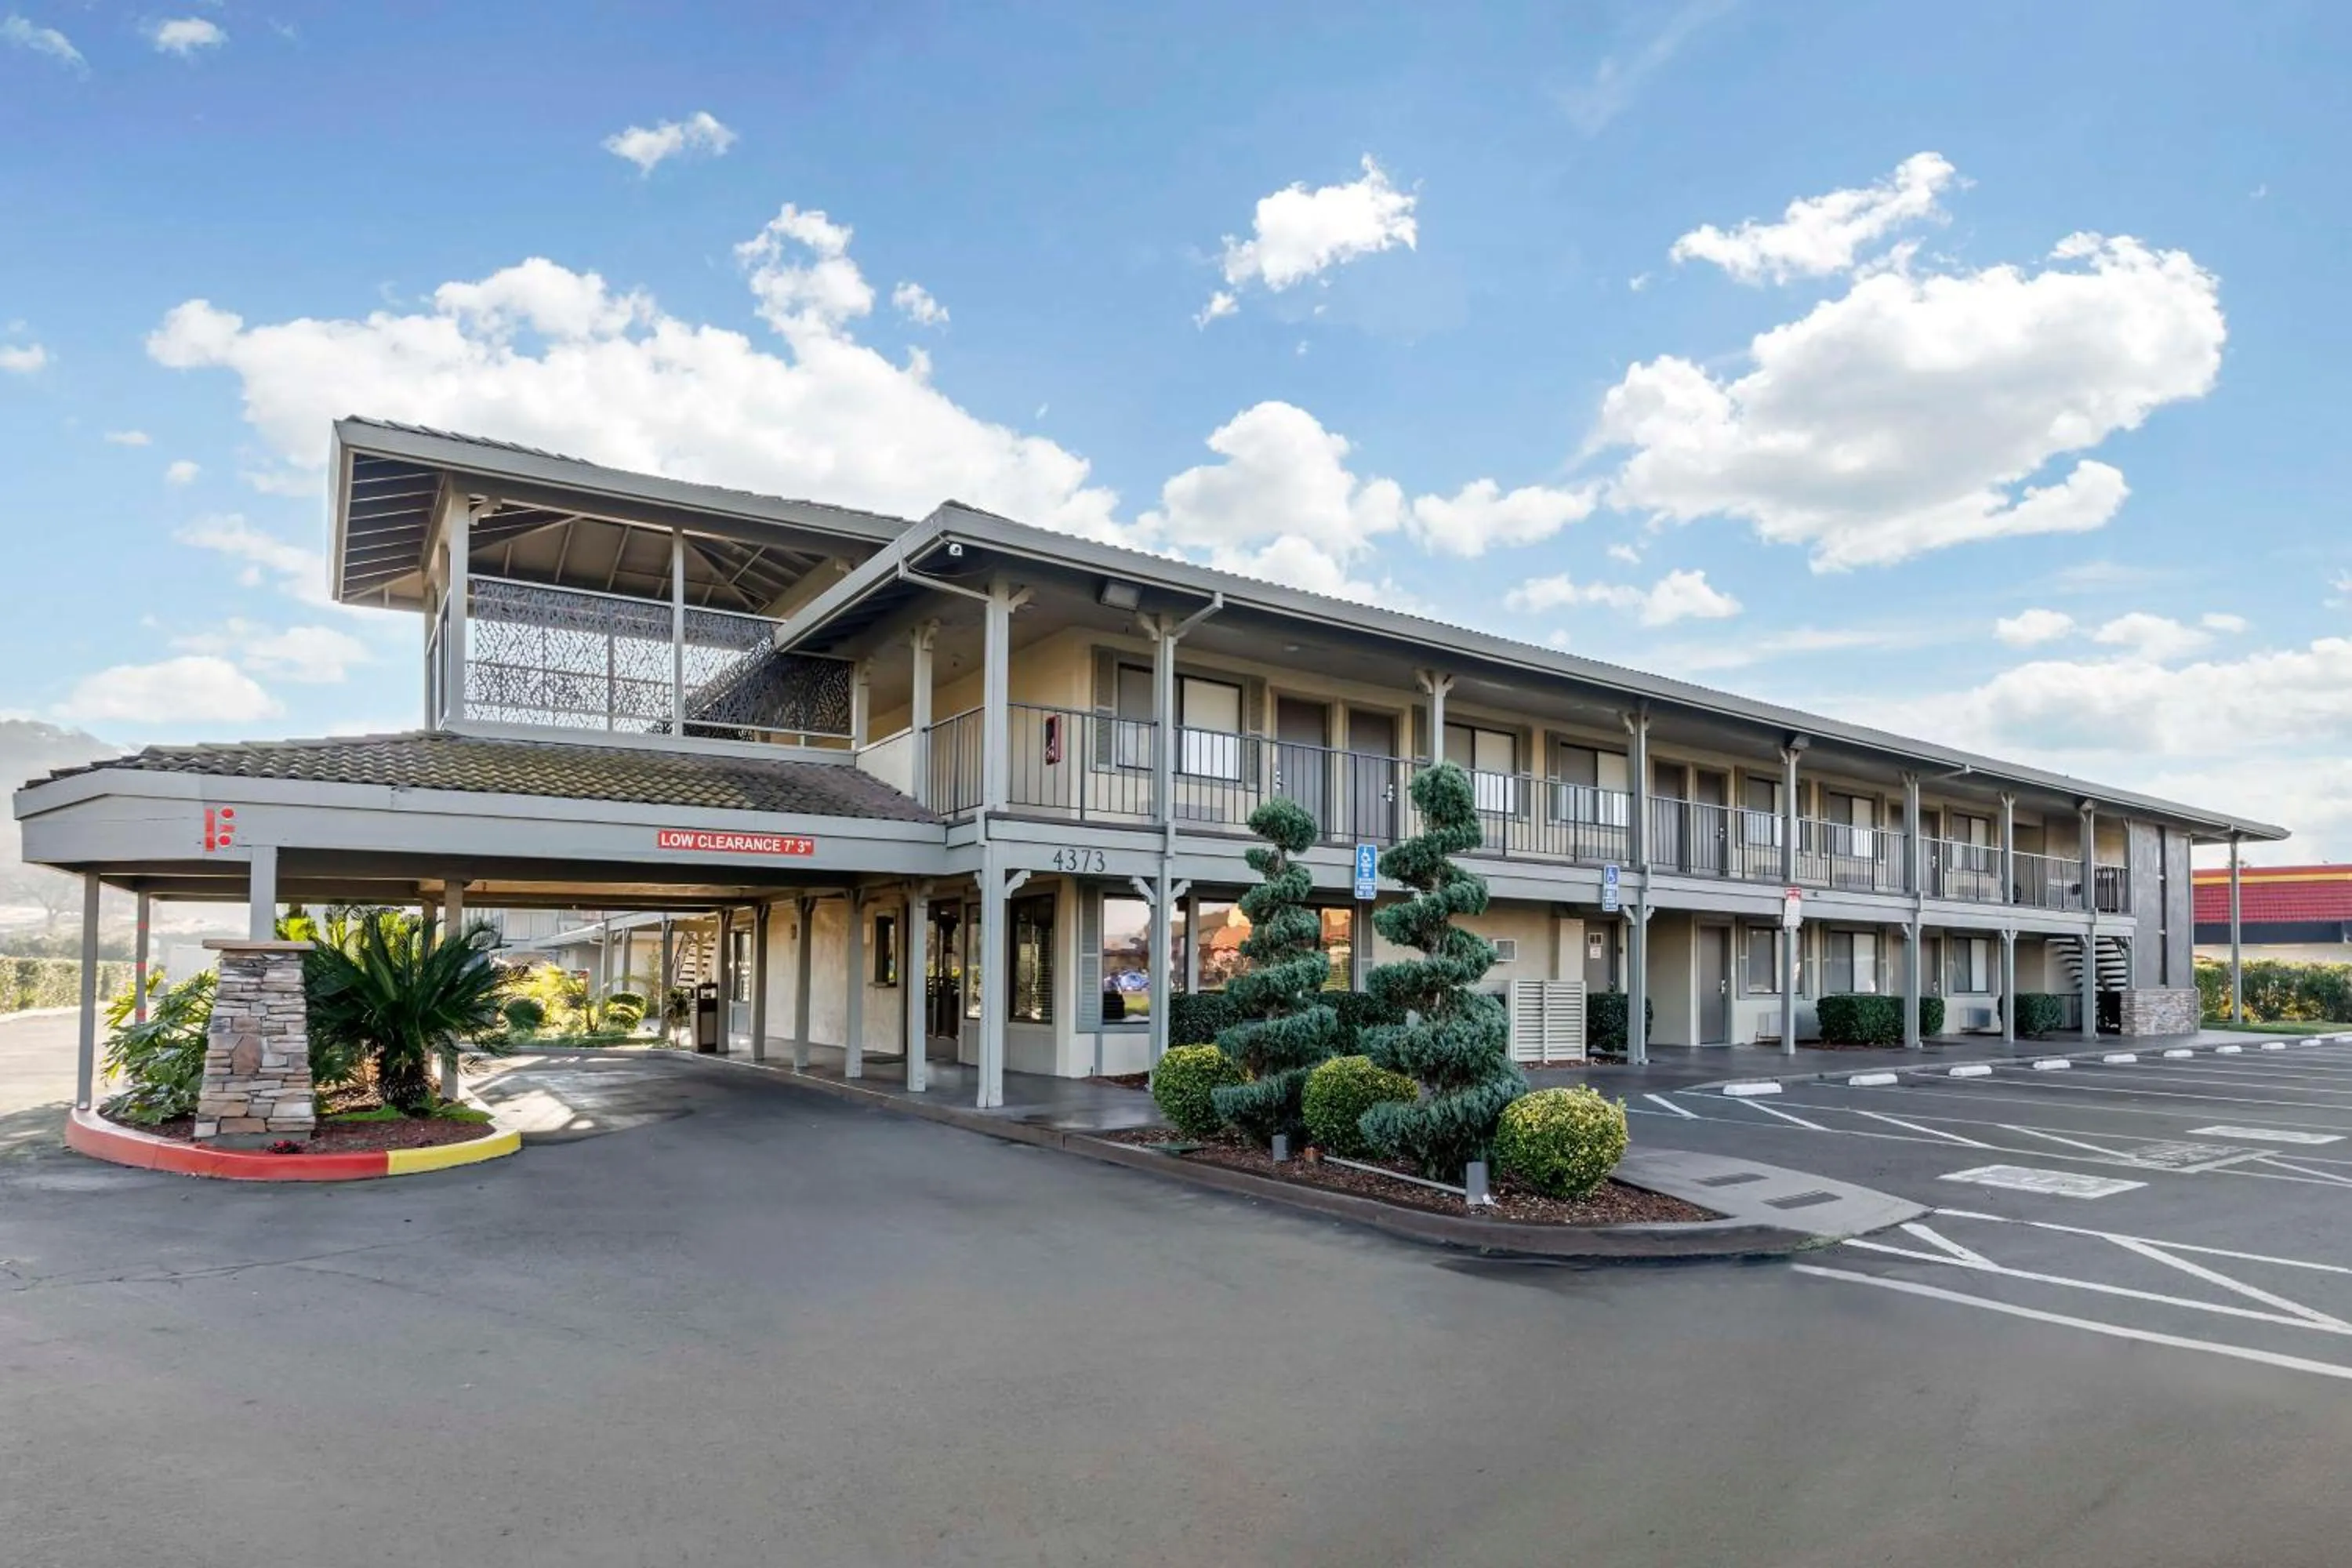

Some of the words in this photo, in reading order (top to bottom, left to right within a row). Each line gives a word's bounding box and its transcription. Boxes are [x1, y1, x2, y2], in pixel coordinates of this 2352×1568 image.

[661, 833, 694, 847] LOW
[698, 835, 781, 852] CLEARANCE
[784, 840, 794, 852] 7'
[797, 840, 811, 854] 3"
[1053, 849, 1105, 872] 4373
